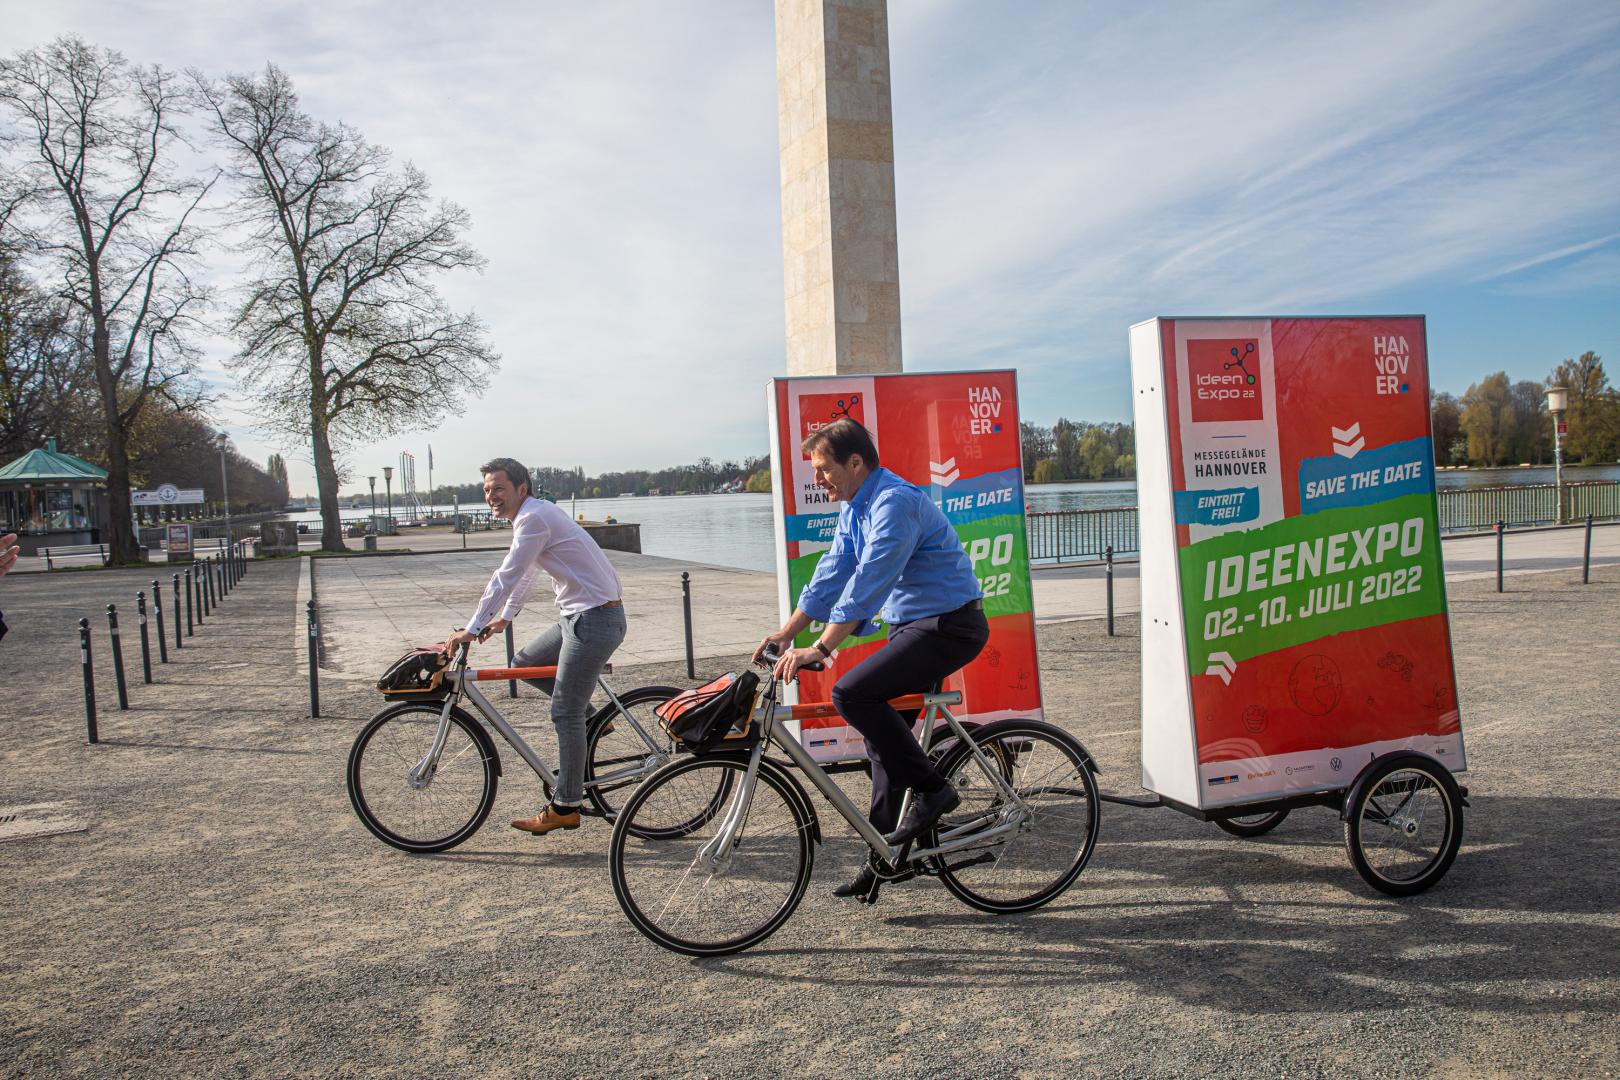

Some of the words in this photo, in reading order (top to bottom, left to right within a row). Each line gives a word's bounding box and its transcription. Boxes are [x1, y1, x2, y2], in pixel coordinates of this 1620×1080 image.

[1374, 335, 1409, 355] HAN
[1374, 355, 1409, 375] NOV
[1196, 373, 1243, 386] Ideen
[968, 386, 1002, 403] HAN
[1198, 388, 1240, 400] Expo
[1243, 390, 1256, 398] 22
[969, 403, 1002, 418] NOV
[1194, 448, 1267, 461] MESSEGELÄNDE
[1195, 461, 1268, 478] HANNOVER
[1305, 475, 1346, 500] SAVE
[1350, 468, 1382, 492] THE
[1383, 460, 1422, 483] DATE
[946, 494, 974, 513] THE
[976, 487, 1013, 508] DATE
[1197, 491, 1246, 509] EINTRITT
[1211, 505, 1241, 520] FREI!
[1203, 516, 1424, 602] IDEENEXPO
[1300, 580, 1353, 619] JULI
[1360, 565, 1423, 605] 2022
